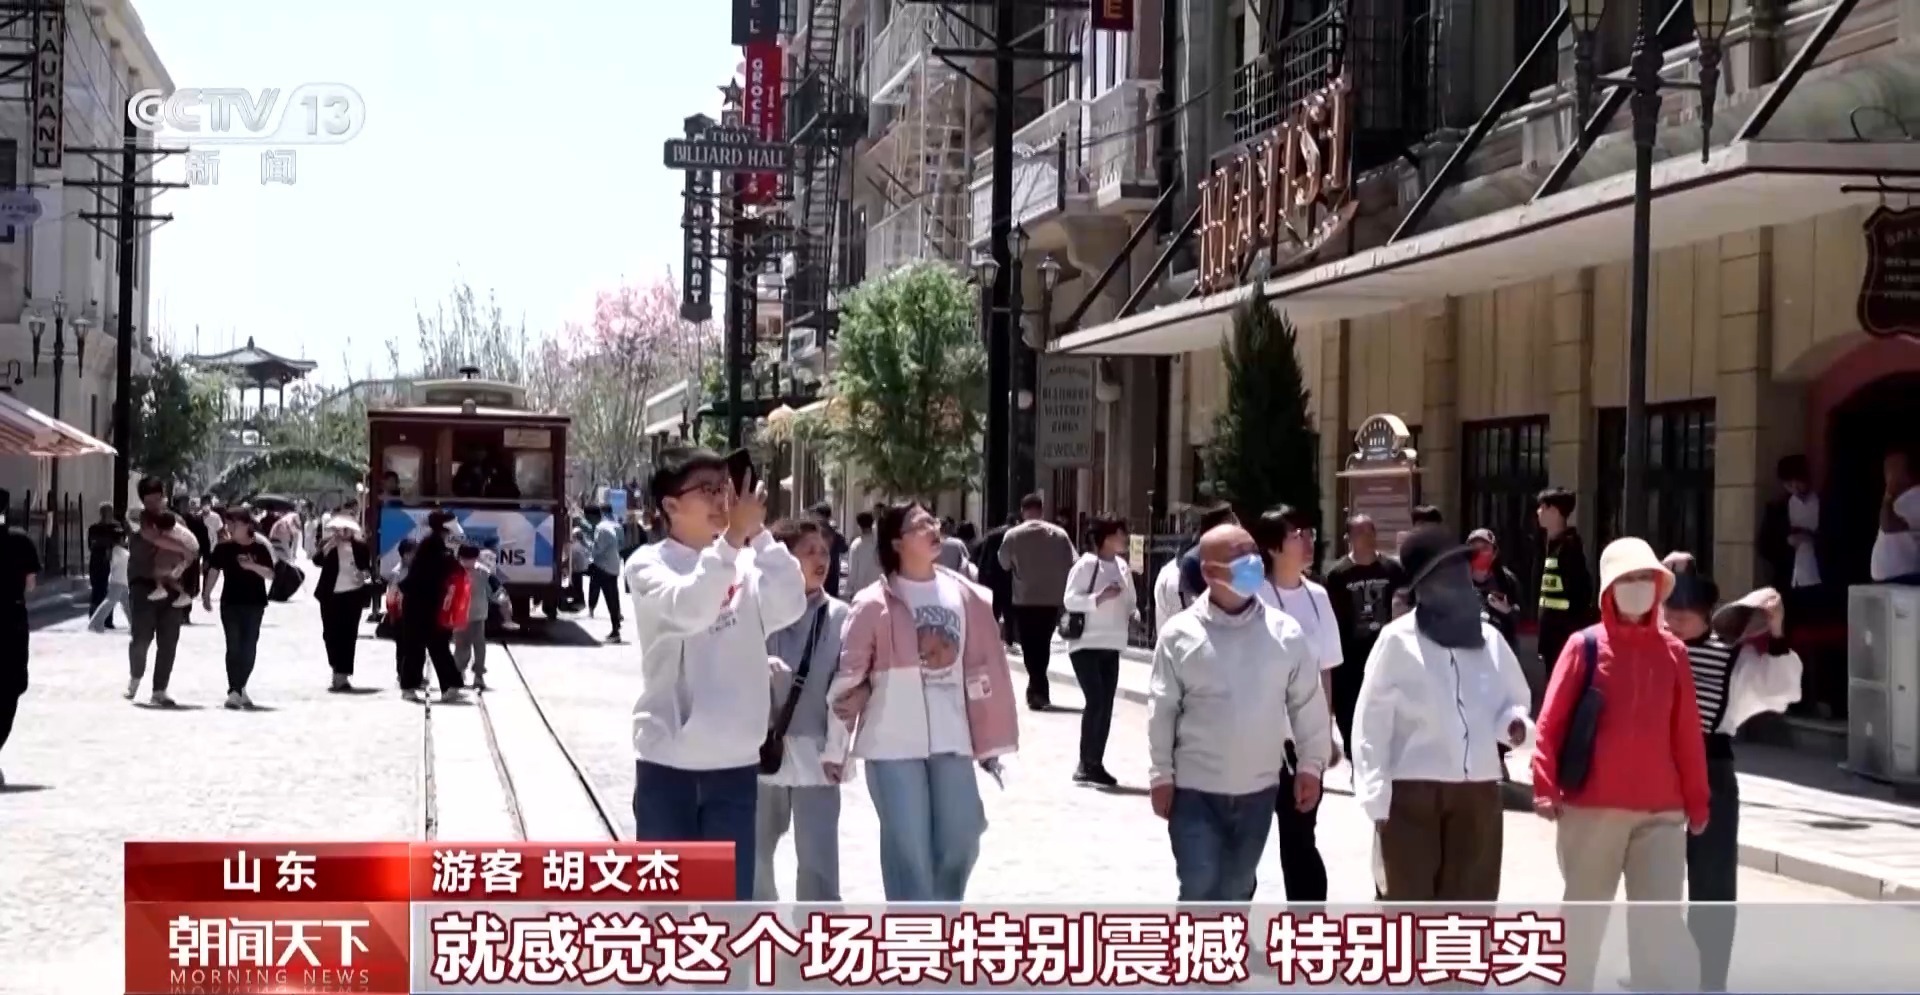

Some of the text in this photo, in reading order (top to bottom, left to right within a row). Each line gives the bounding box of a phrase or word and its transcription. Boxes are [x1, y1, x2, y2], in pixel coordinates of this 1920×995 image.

[712, 131, 748, 144] TROY
[673, 145, 786, 168] BILLIARD HALL
